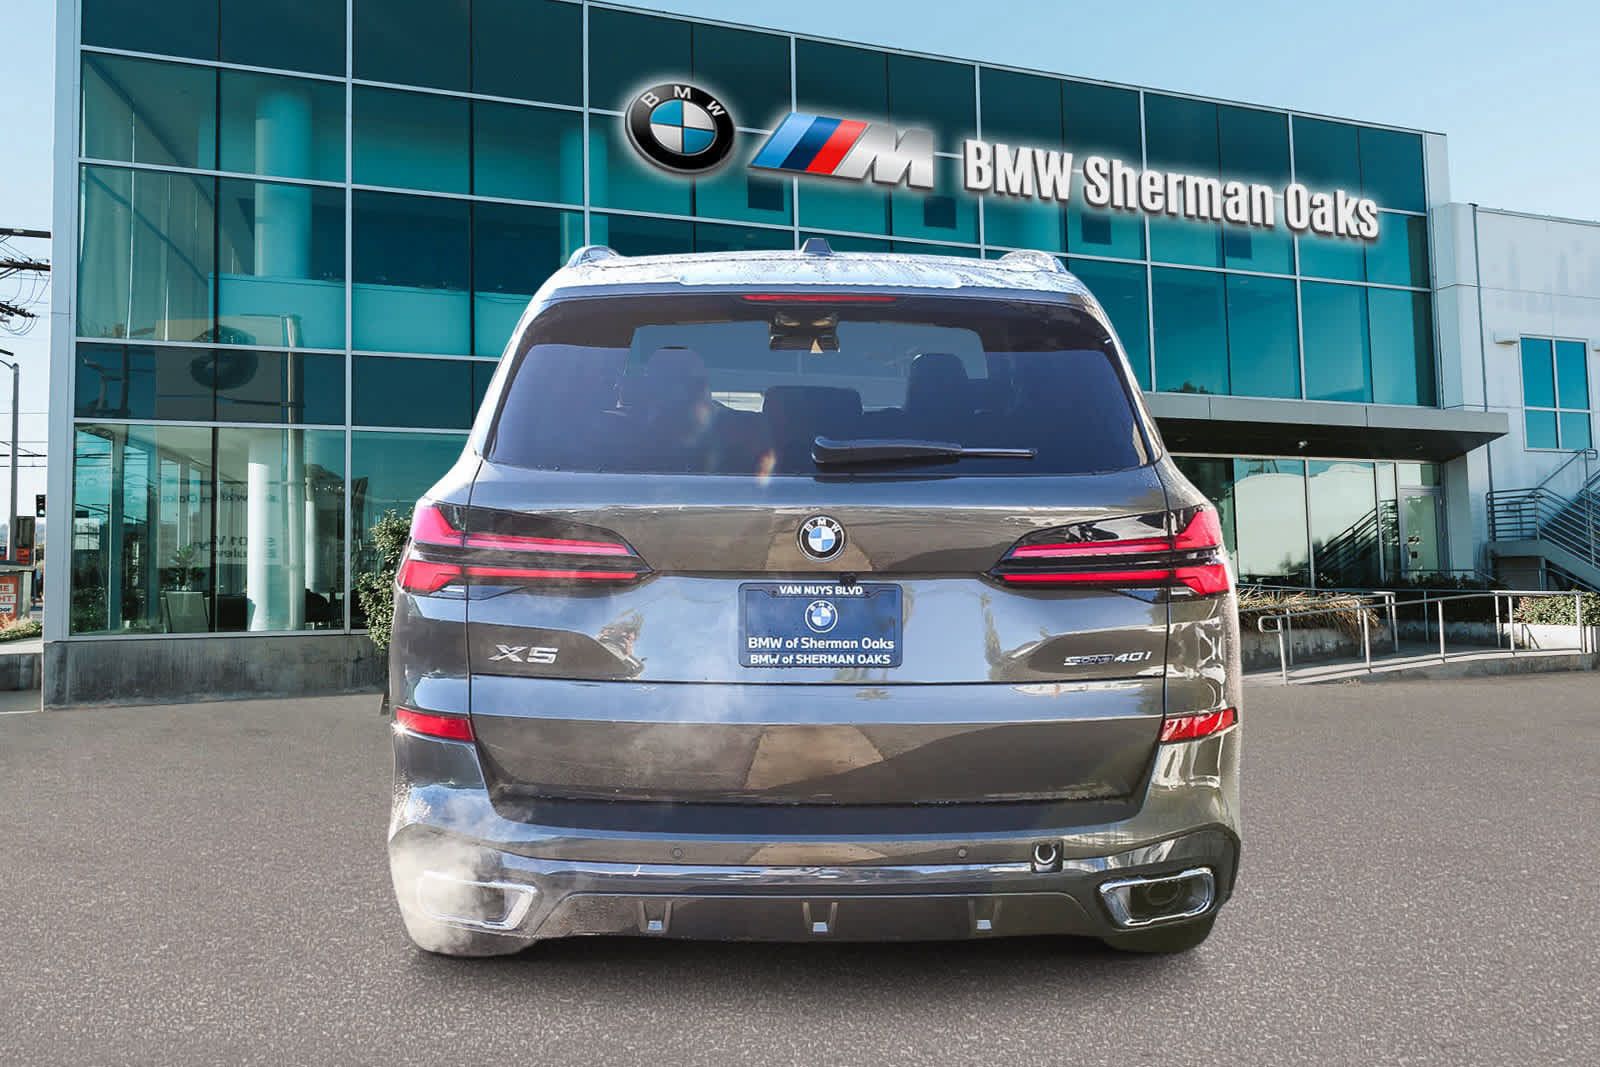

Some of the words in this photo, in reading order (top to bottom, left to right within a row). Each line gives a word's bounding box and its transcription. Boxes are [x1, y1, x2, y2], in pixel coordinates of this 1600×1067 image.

[640, 86, 725, 117] BMW
[964, 138, 1073, 201] BMW
[1083, 155, 1274, 228] Sherman
[1284, 183, 1379, 240] Oaks
[804, 517, 840, 532] BMW
[779, 586, 801, 595] VAN
[803, 586, 833, 595] NUYS
[836, 586, 863, 595] BLVD
[748, 637, 782, 649] BMW
[785, 637, 799, 649] of
[801, 637, 859, 649] Sherman
[861, 637, 894, 649] Oaks
[487, 644, 559, 664] X5
[750, 654, 780, 665] BMW
[782, 654, 794, 665] of
[795, 654, 855, 665] SHERMAN
[857, 654, 891, 665] OAKS
